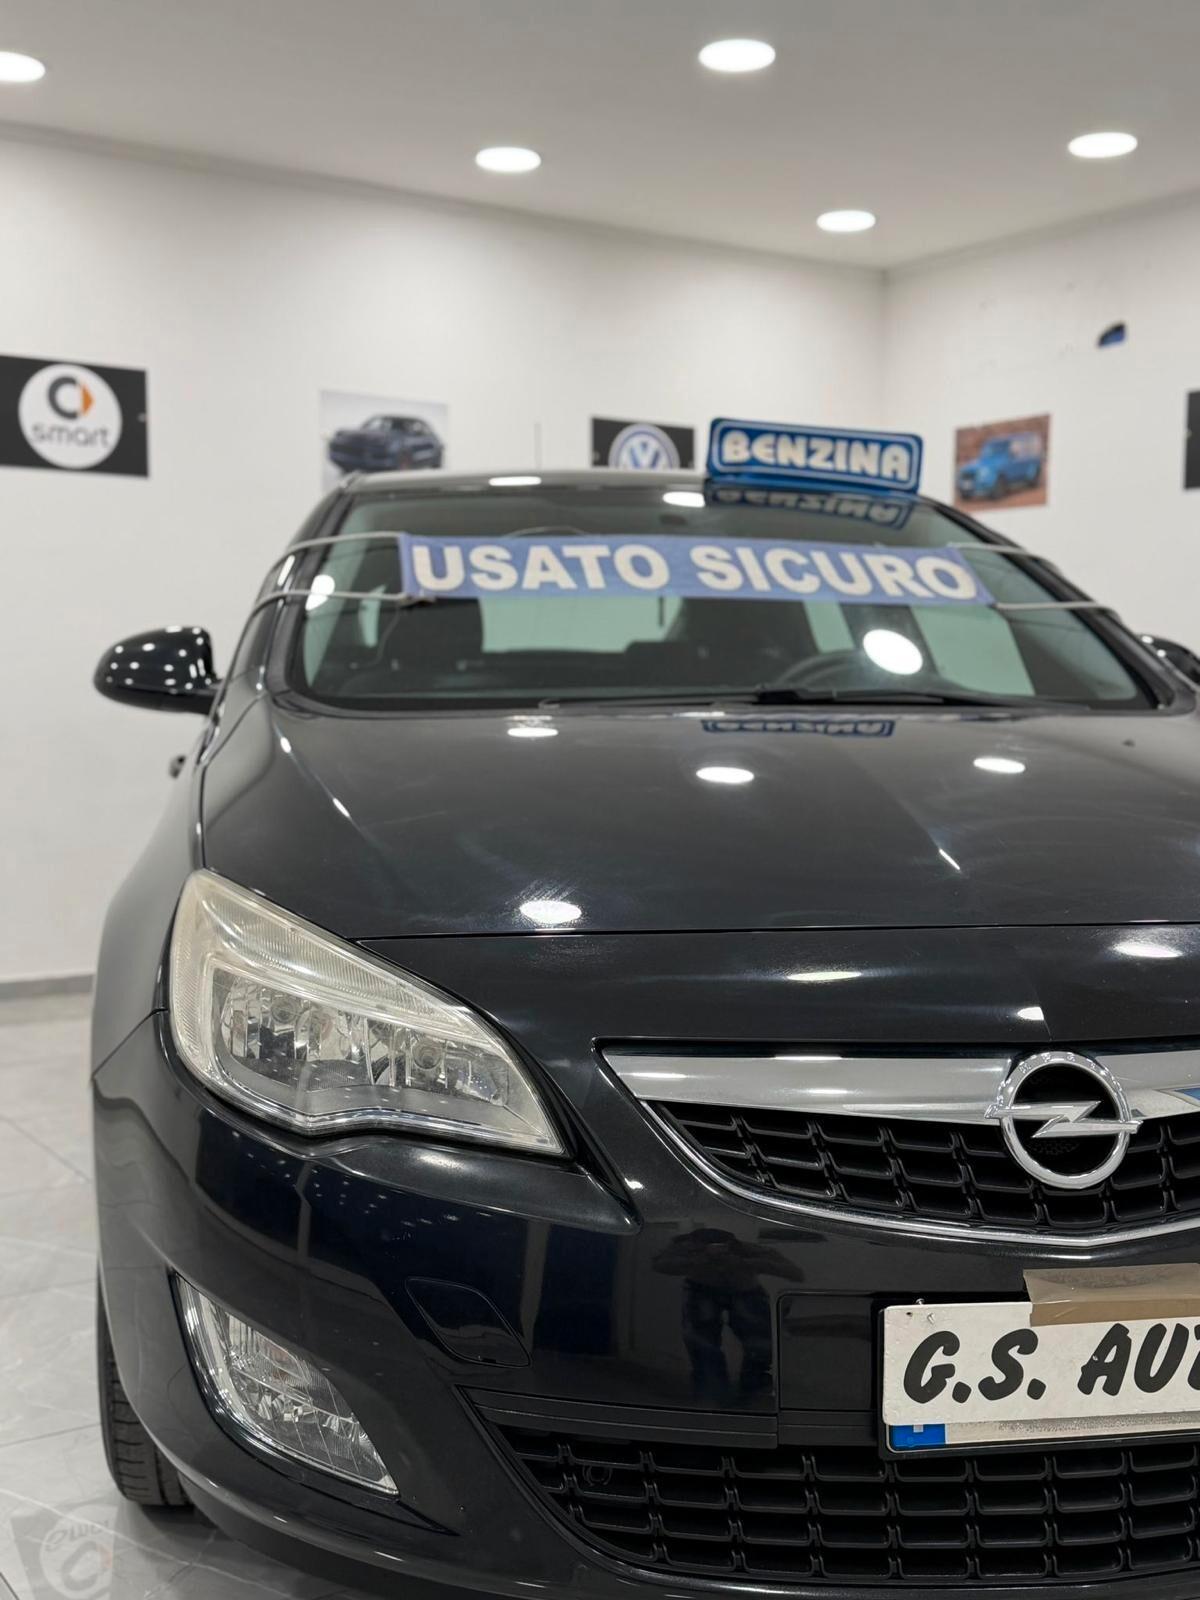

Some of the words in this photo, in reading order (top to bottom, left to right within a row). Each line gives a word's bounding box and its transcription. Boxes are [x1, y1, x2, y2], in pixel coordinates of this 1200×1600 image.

[31, 422, 109, 447] smart
[721, 429, 911, 482] BENZINA
[412, 543, 671, 592] USATO
[689, 544, 978, 601] SICURO
[903, 1328, 1047, 1404] G.S.
[1077, 1322, 1200, 1397] AU
